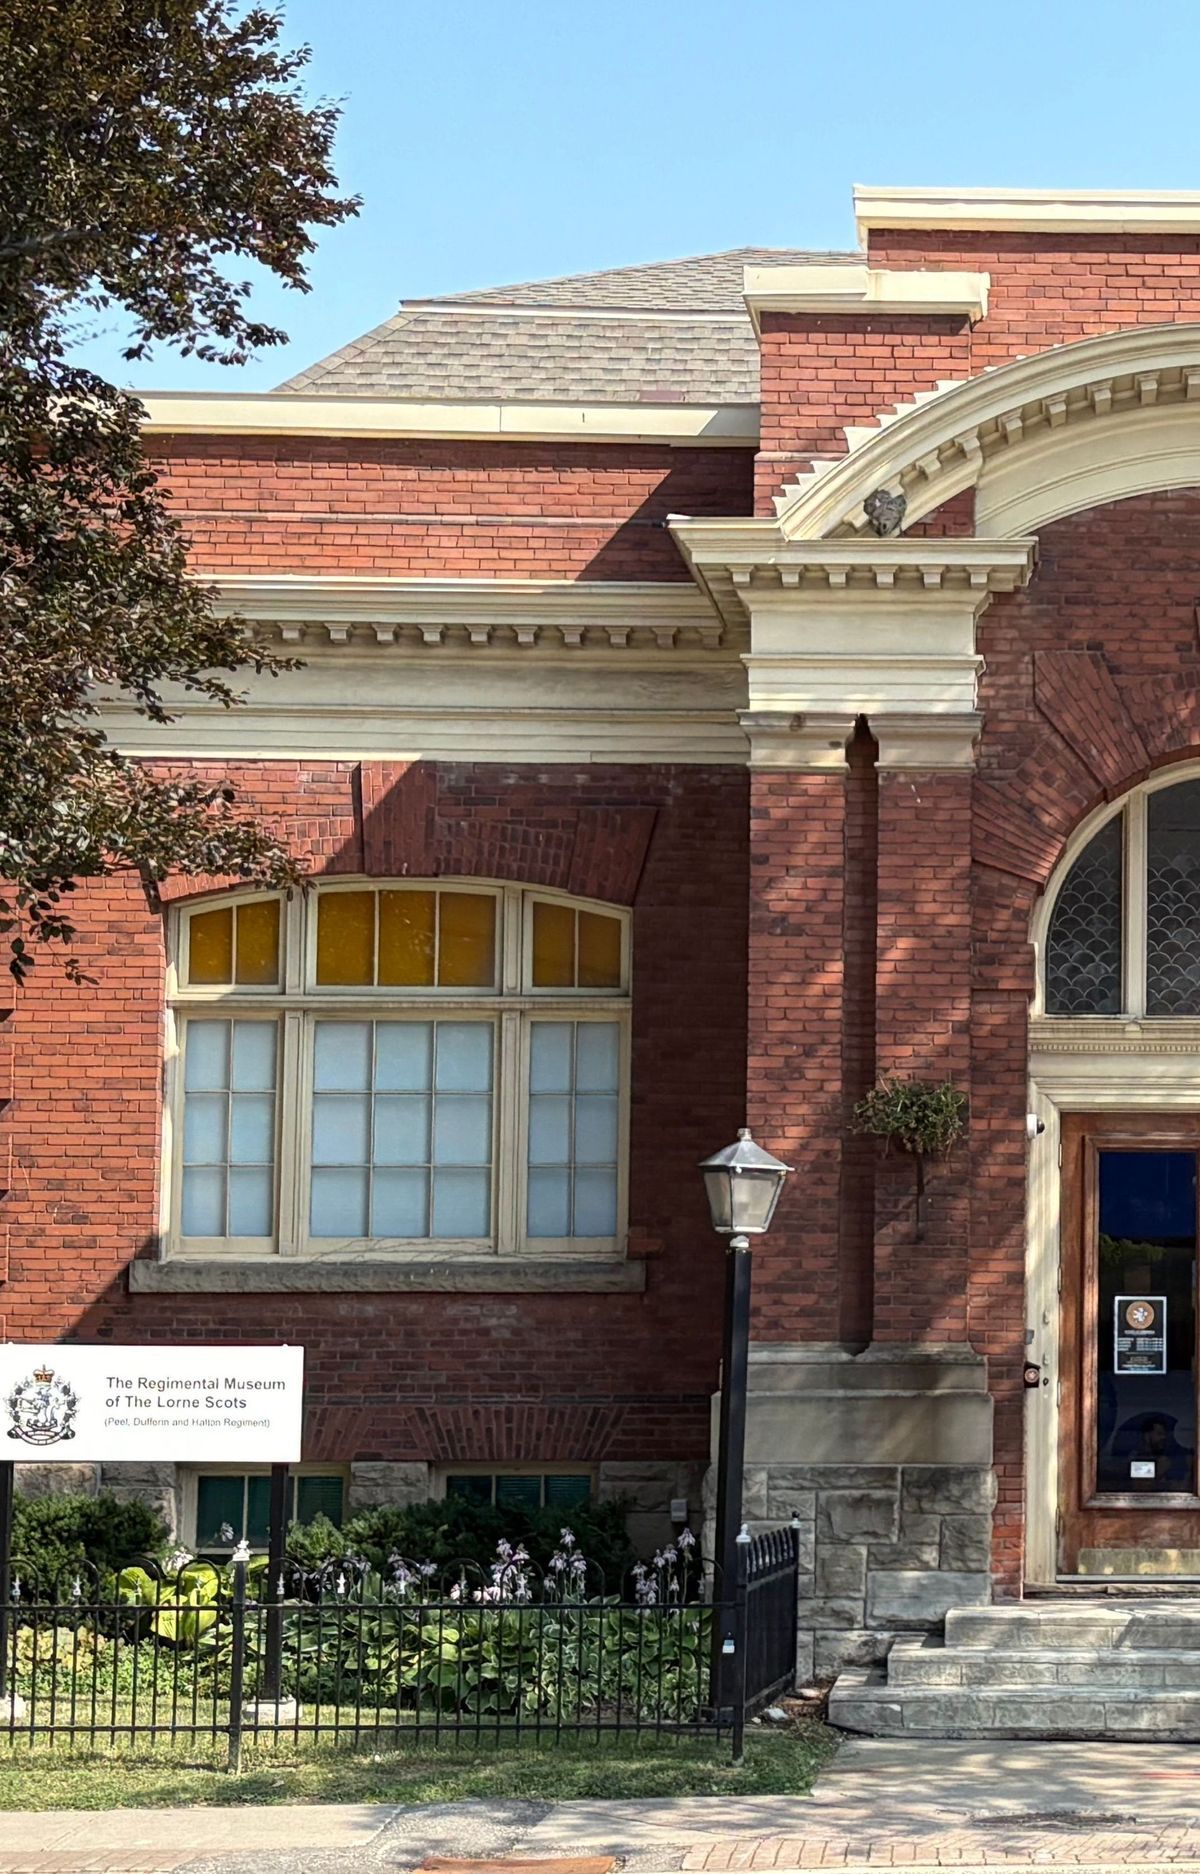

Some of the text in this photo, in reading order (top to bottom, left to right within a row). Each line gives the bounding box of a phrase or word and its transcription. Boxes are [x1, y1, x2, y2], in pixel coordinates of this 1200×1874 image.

[105, 1376, 286, 1393] The Regimental Museum
[105, 1394, 247, 1409] of The Lorne Scots
[104, 1416, 271, 1430] (Peel, Dufferin and Halton Regiment)
